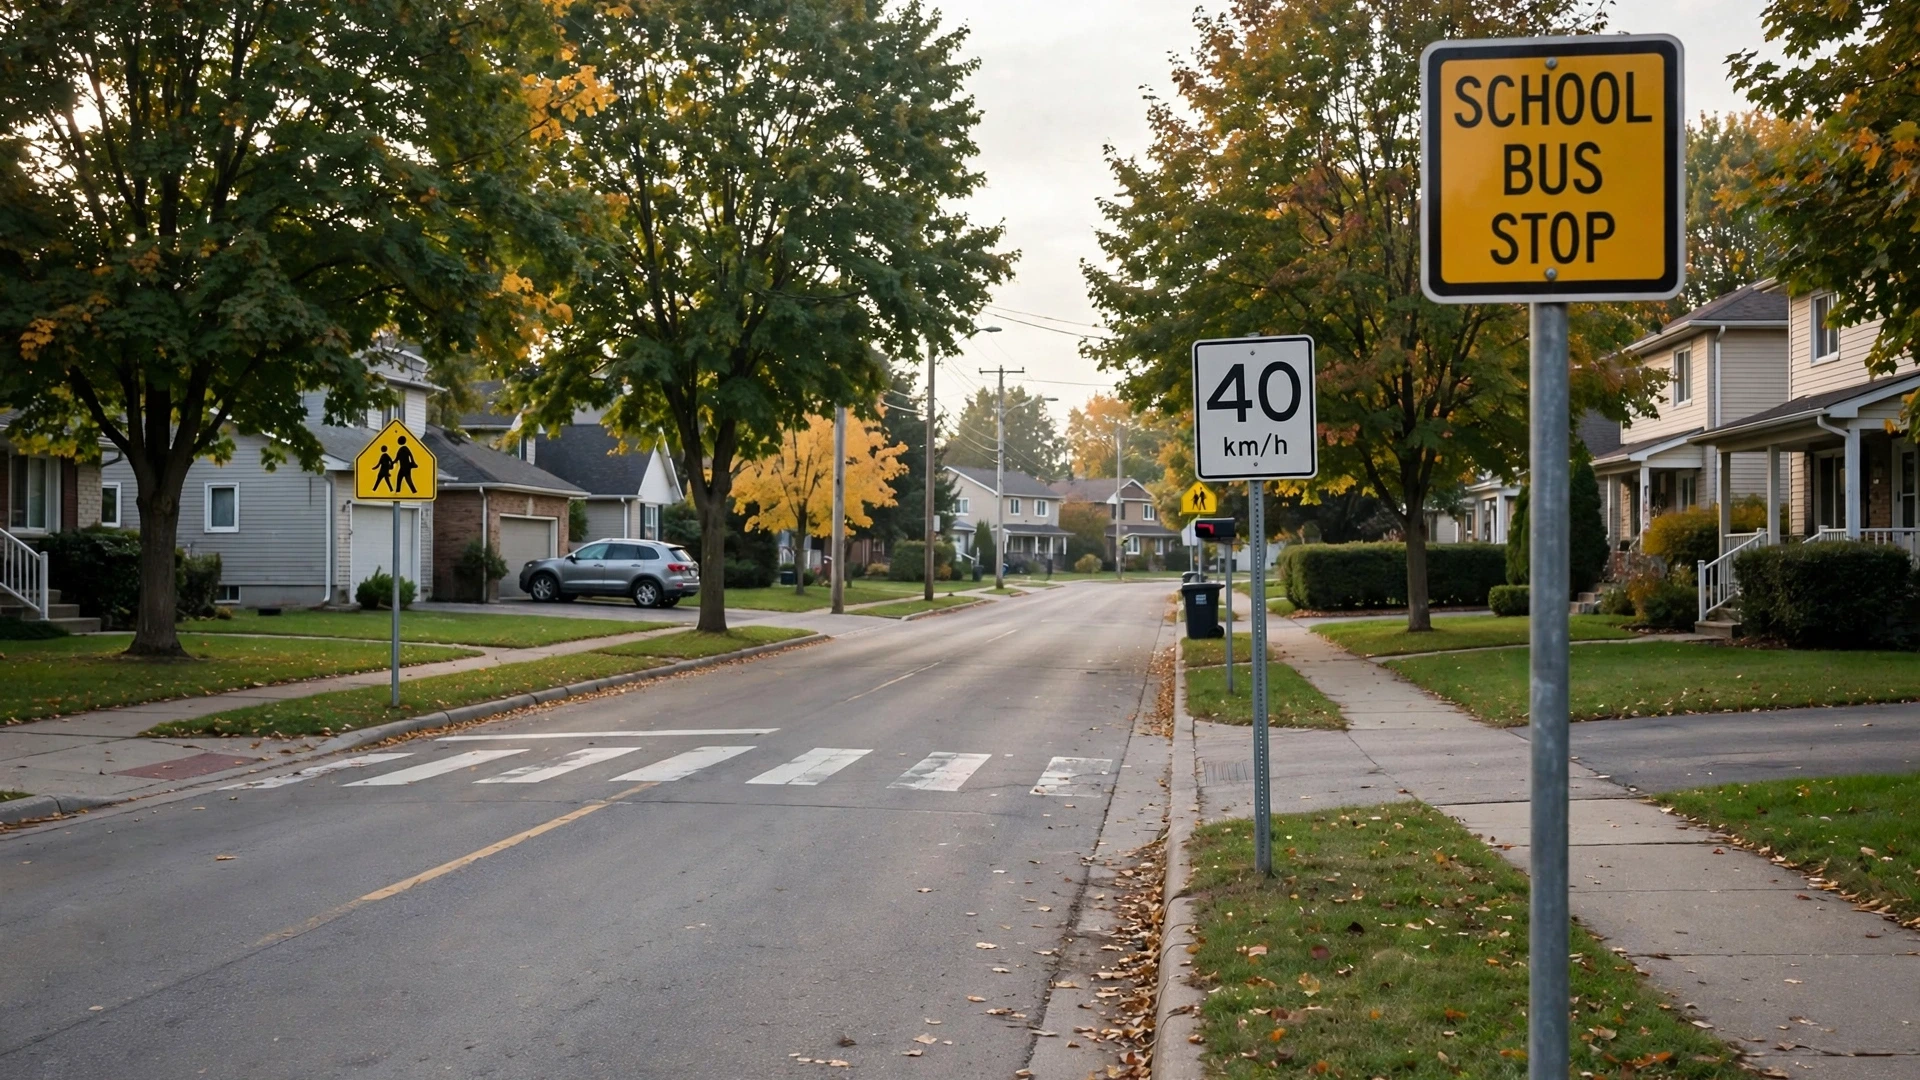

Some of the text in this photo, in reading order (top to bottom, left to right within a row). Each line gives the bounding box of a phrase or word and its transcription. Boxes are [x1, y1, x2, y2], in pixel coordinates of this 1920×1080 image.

[1454, 71, 1653, 129] SCHOOL
[1503, 141, 1603, 196] BUS
[1490, 210, 1616, 265] STOP
[1206, 360, 1302, 423] 40
[1223, 432, 1288, 458] km/h
